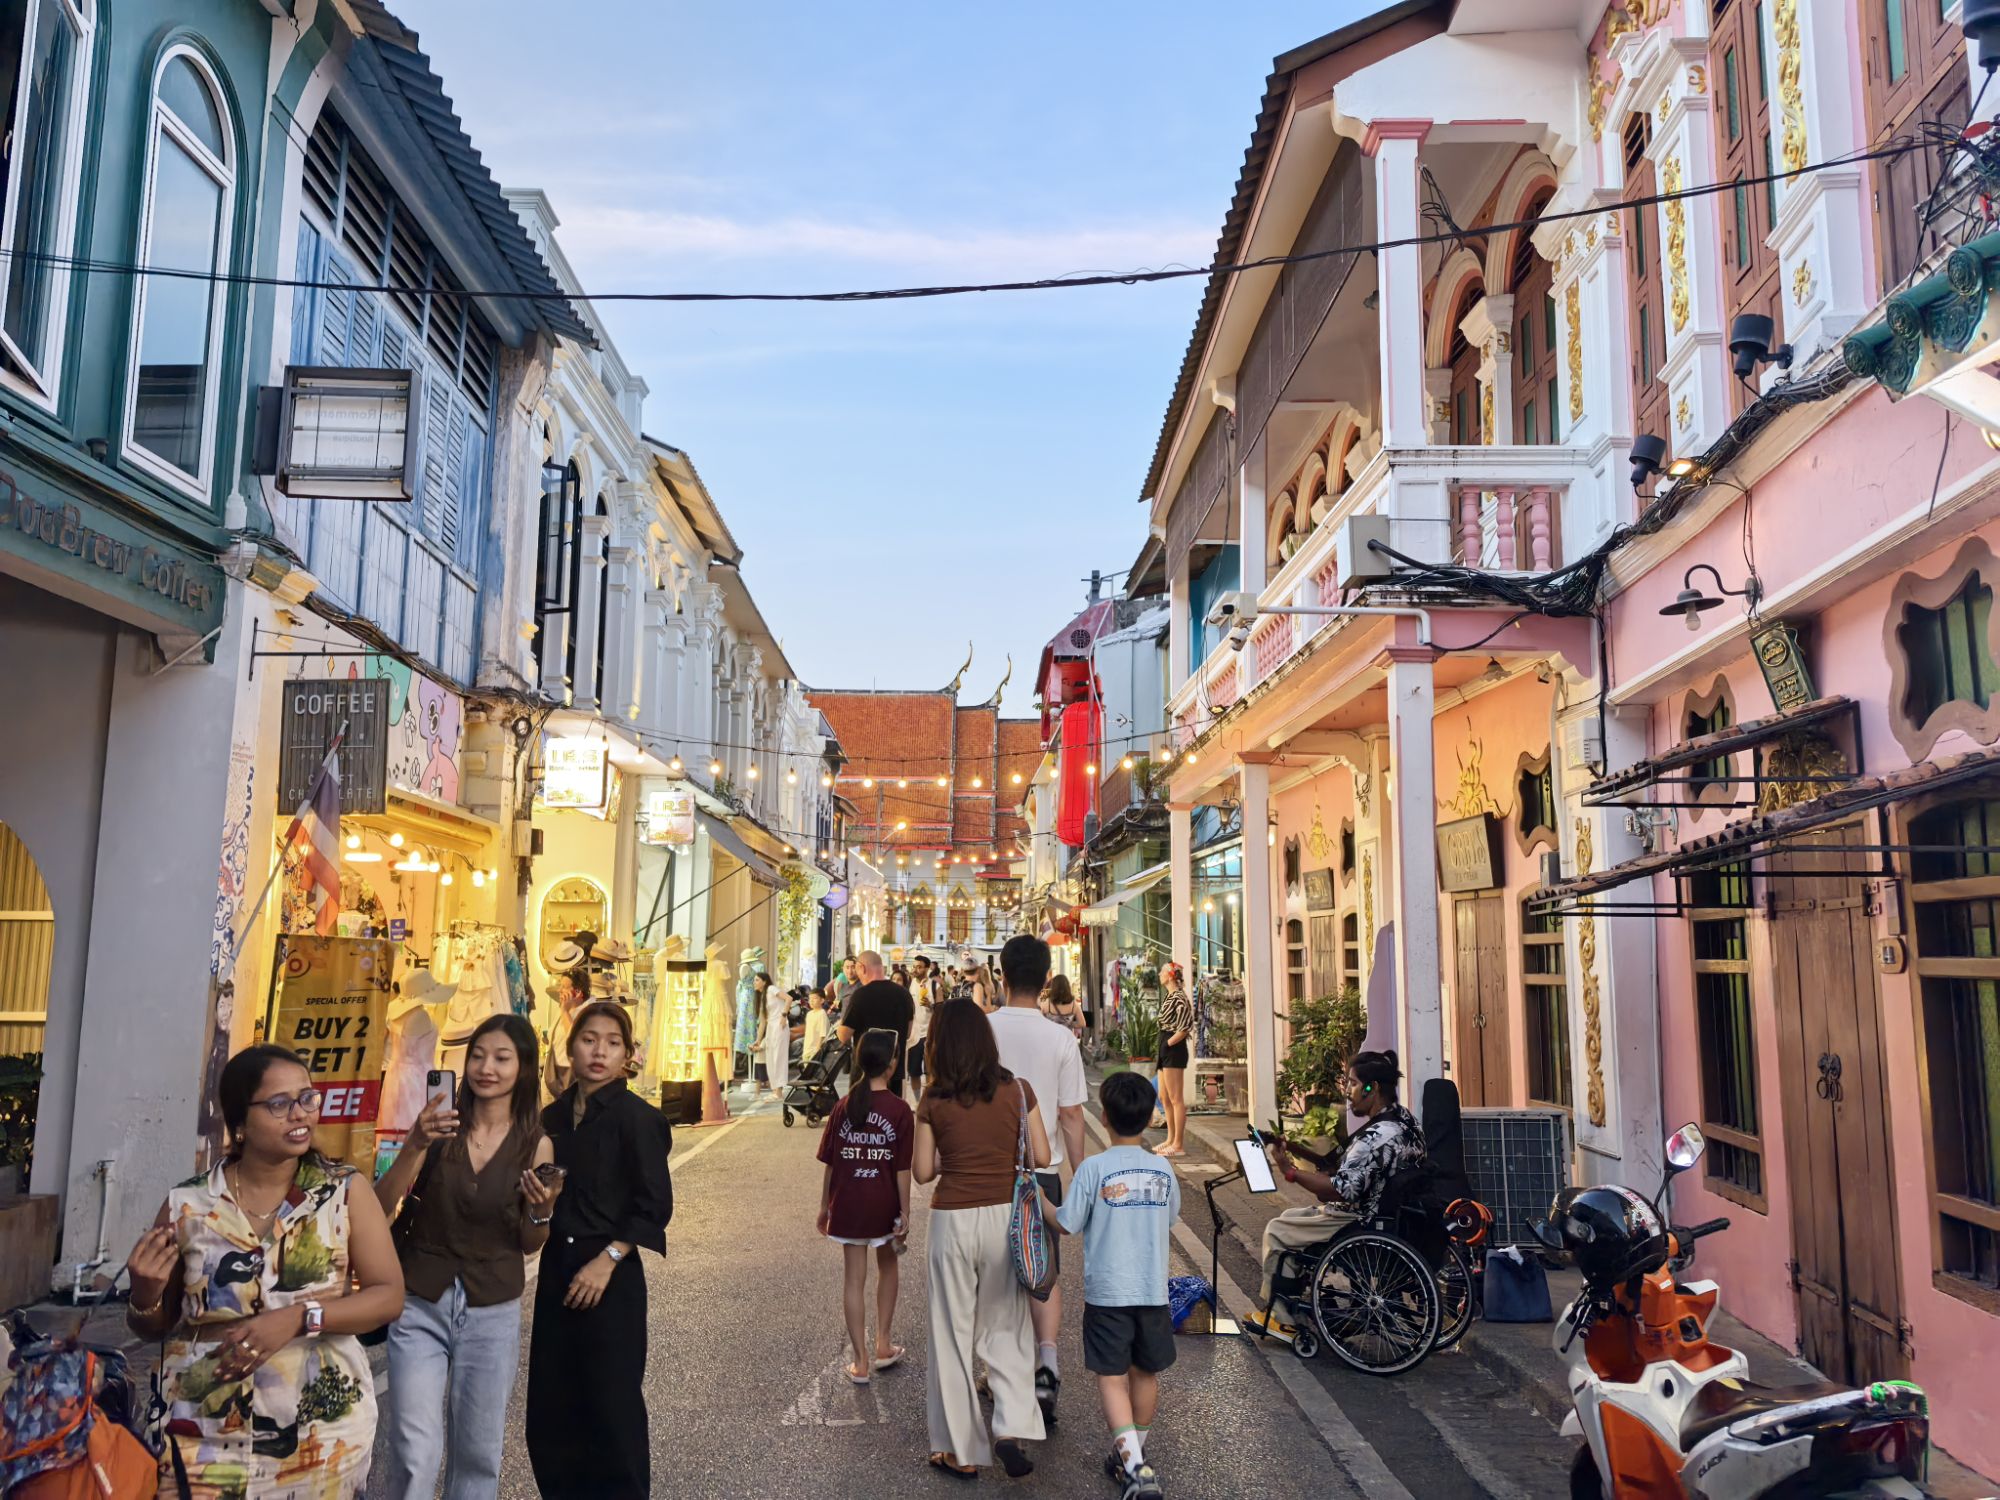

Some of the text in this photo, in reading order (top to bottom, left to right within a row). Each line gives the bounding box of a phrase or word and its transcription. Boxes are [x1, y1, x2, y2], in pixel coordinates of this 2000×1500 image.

[294, 693, 375, 715] COFFEE
[308, 773, 355, 786] CFT
[288, 788, 374, 801] CHLATE
[305, 996, 368, 1006] SPECIAL OFFER
[294, 1016, 370, 1040] BUY 2
[355, 1046, 365, 1072] 1
[847, 1132, 887, 1145] AROUND
